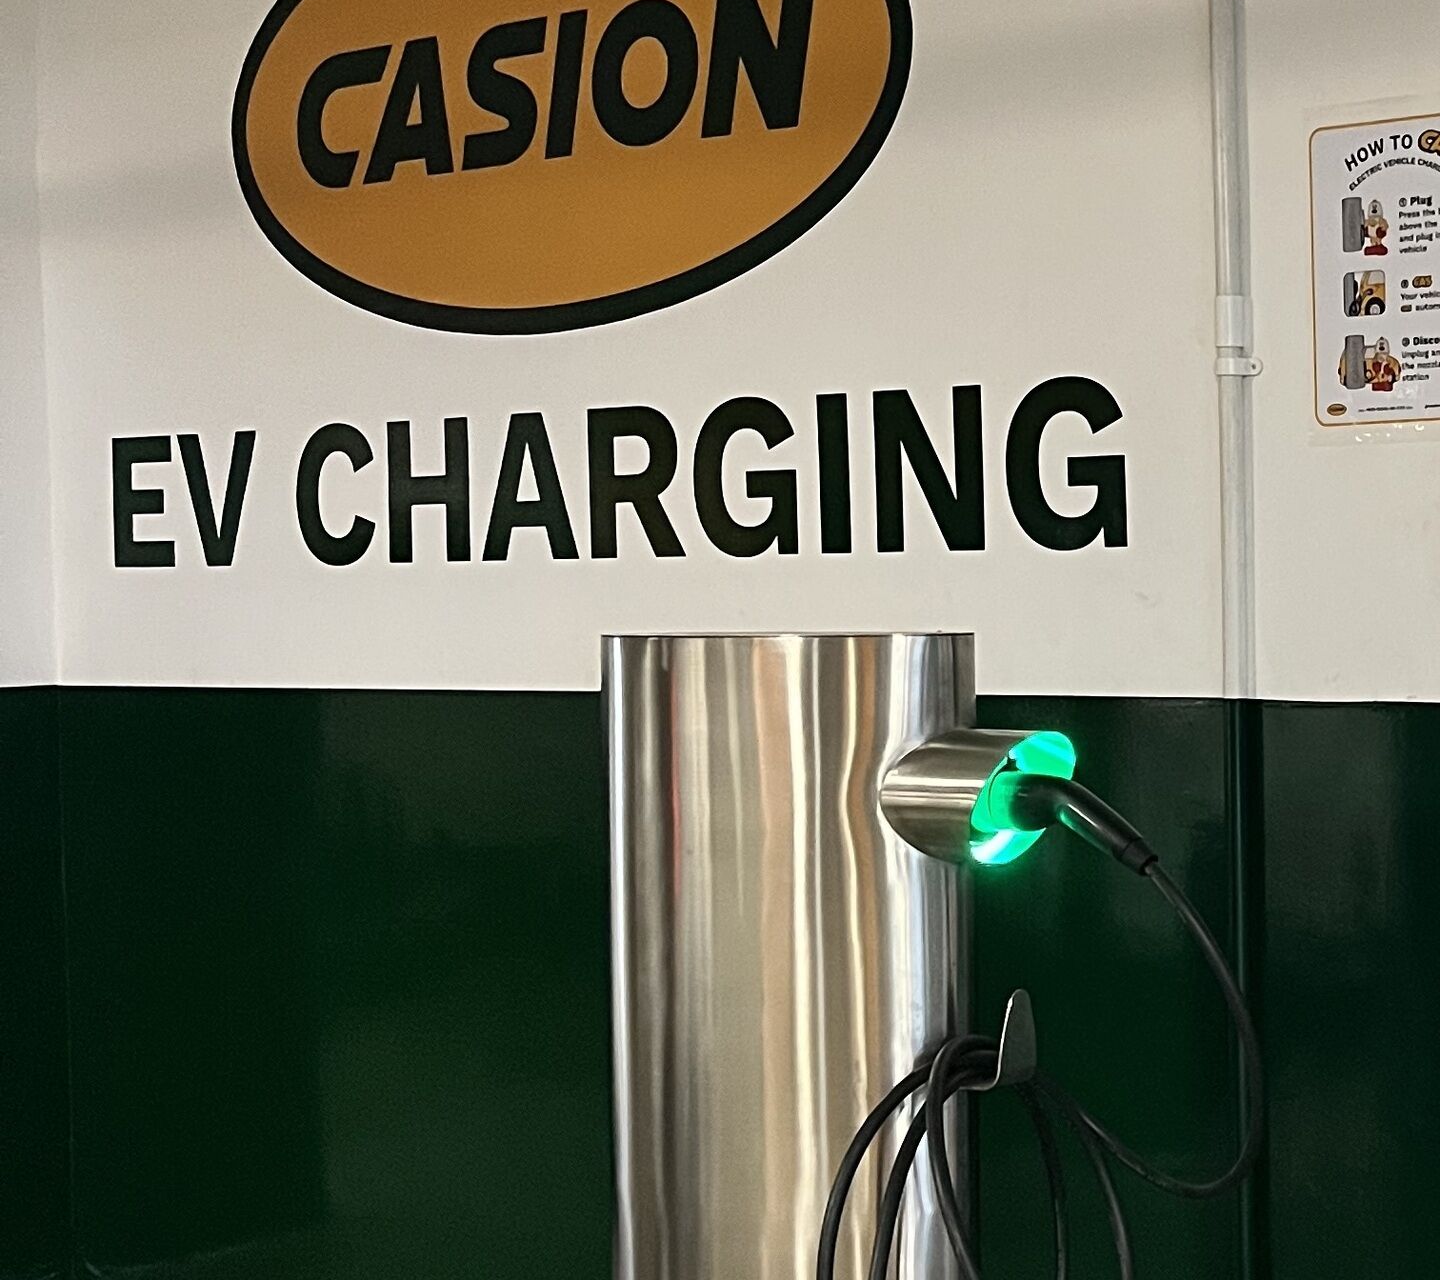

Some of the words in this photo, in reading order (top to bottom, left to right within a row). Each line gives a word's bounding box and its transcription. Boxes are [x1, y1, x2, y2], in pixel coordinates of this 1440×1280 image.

[1344, 138, 1384, 172] HOW
[1390, 134, 1413, 150] TO
[1349, 164, 1382, 191] ELECTRIC
[1410, 195, 1433, 207] Plug
[1399, 210, 1420, 219] Press
[1423, 208, 1435, 217] the
[1399, 222, 1422, 231] above
[1425, 220, 1438, 228] the
[1399, 233, 1414, 243] and
[1415, 232, 1433, 243] plug
[1399, 245, 1428, 254] vehicle
[1400, 291, 1418, 300] Your
[1401, 350, 1430, 359] Unplug
[1402, 362, 1415, 370] the
[111, 430, 255, 568] EV
[295, 375, 1128, 565] CHARGING
